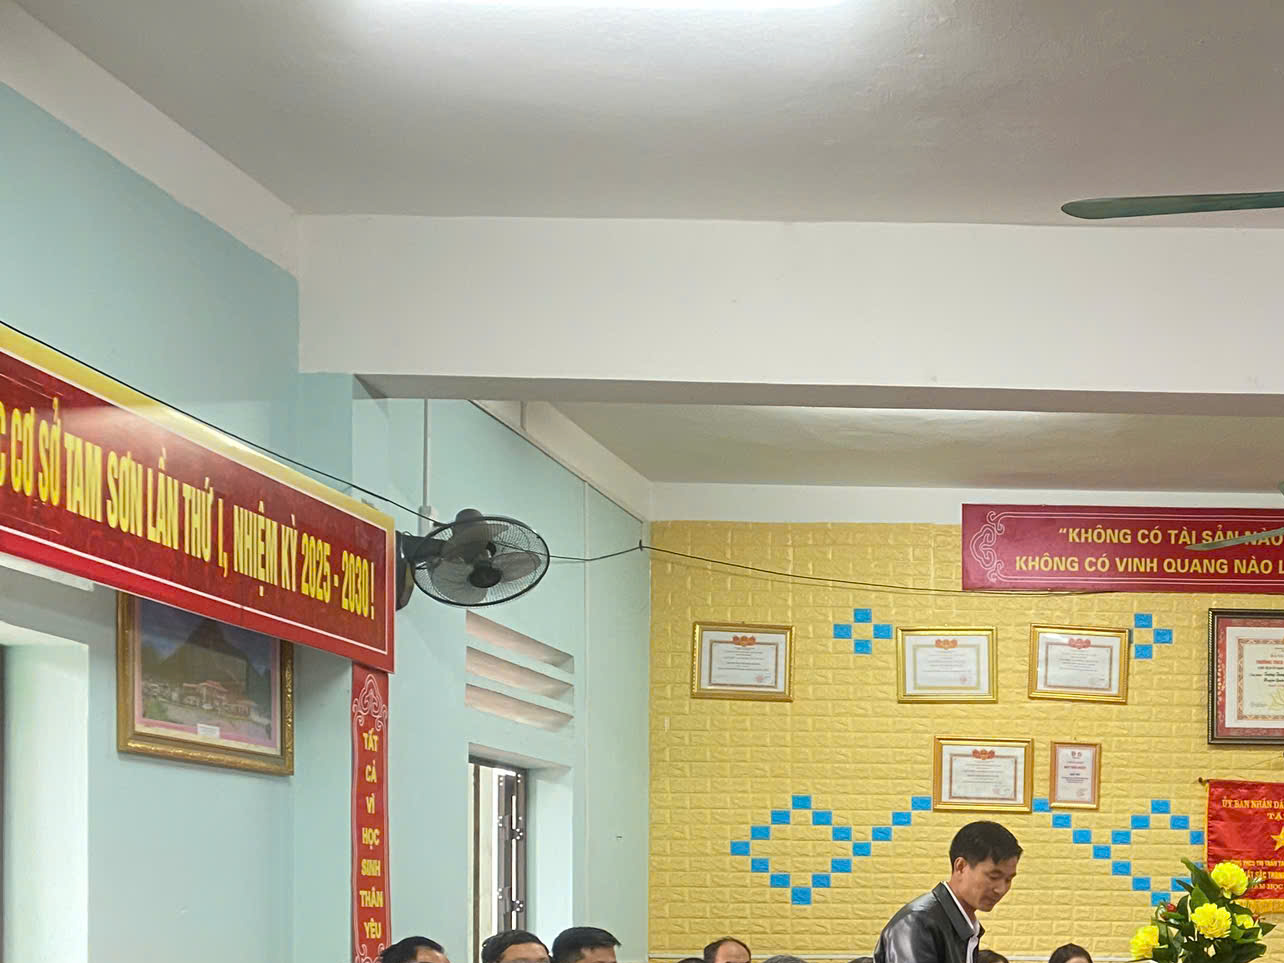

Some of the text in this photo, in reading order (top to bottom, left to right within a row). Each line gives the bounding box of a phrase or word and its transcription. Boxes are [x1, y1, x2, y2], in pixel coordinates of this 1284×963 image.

[11, 406, 35, 497] CƠ
[38, 397, 61, 507] SỞ
[64, 432, 102, 523] TAM
[106, 450, 142, 537] SƠN
[146, 448, 179, 550] LẦN
[182, 477, 213, 563] THỨ
[233, 500, 278, 597] NHIỆM
[281, 514, 298, 592] KỲ
[301, 532, 331, 604] 2025
[1137, 525, 1163, 545] CÓ
[1167, 526, 1197, 545] TÀI
[1015, 552, 1079, 572] KHÔNG
[1084, 552, 1110, 573] CÓ
[1115, 556, 1158, 573] VINH
[1163, 556, 1228, 575] QUANG
[1233, 555, 1273, 574] NÀO
[360, 728, 384, 939] TẤT CẢ VÌ HỌC SINH THÂN YÊU
